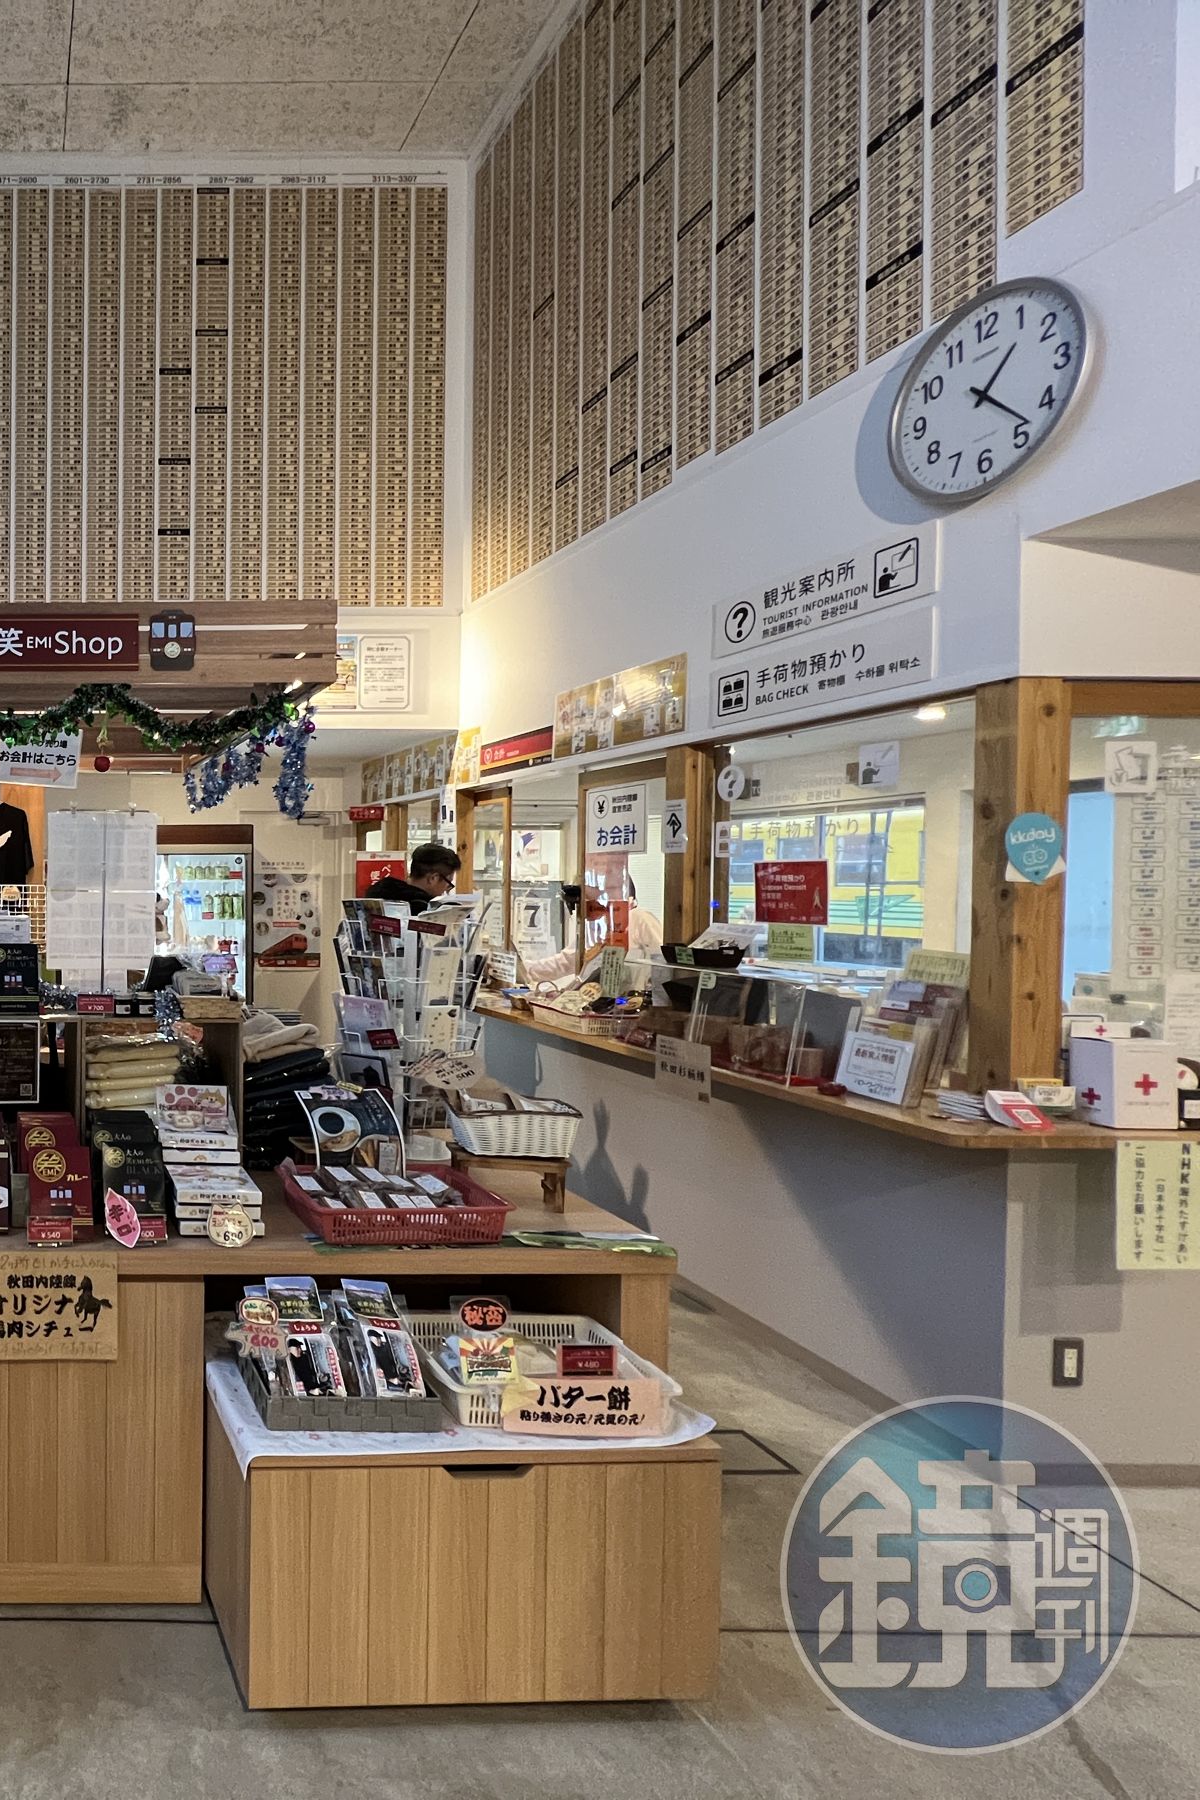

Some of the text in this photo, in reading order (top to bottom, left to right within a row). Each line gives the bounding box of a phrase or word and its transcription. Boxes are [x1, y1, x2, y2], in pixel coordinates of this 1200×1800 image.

[974, 311, 999, 343] 12
[1015, 304, 1025, 330] 1
[1039, 312, 1057, 343] 2
[946, 340, 963, 369] 11
[1053, 341, 1071, 370] 3
[921, 375, 943, 404] 10
[1038, 384, 1056, 410] 4
[913, 416, 926, 440] 9
[1013, 422, 1030, 449] 5
[927, 441, 940, 464] 8
[948, 452, 962, 478] 7
[977, 449, 994, 474] 6
[763, 558, 856, 610] 観光案内所
[762, 583, 869, 626] TOURIST INFORMATION
[26, 636, 52, 649] EMI
[54, 630, 123, 659] Shop
[756, 643, 866, 689] 手荷物預かり
[755, 692, 774, 706] BAG
[776, 684, 809, 702] CHECK
[0, 750, 77, 766] お会計はこちら
[597, 824, 637, 846] お会計
[524, 905, 541, 928] 7
[66, 1174, 89, 1182] カレー
[7, 1274, 77, 1289] 秋田内陸線
[464, 1304, 503, 1326] 秘密
[537, 1385, 631, 1411] バター餅
